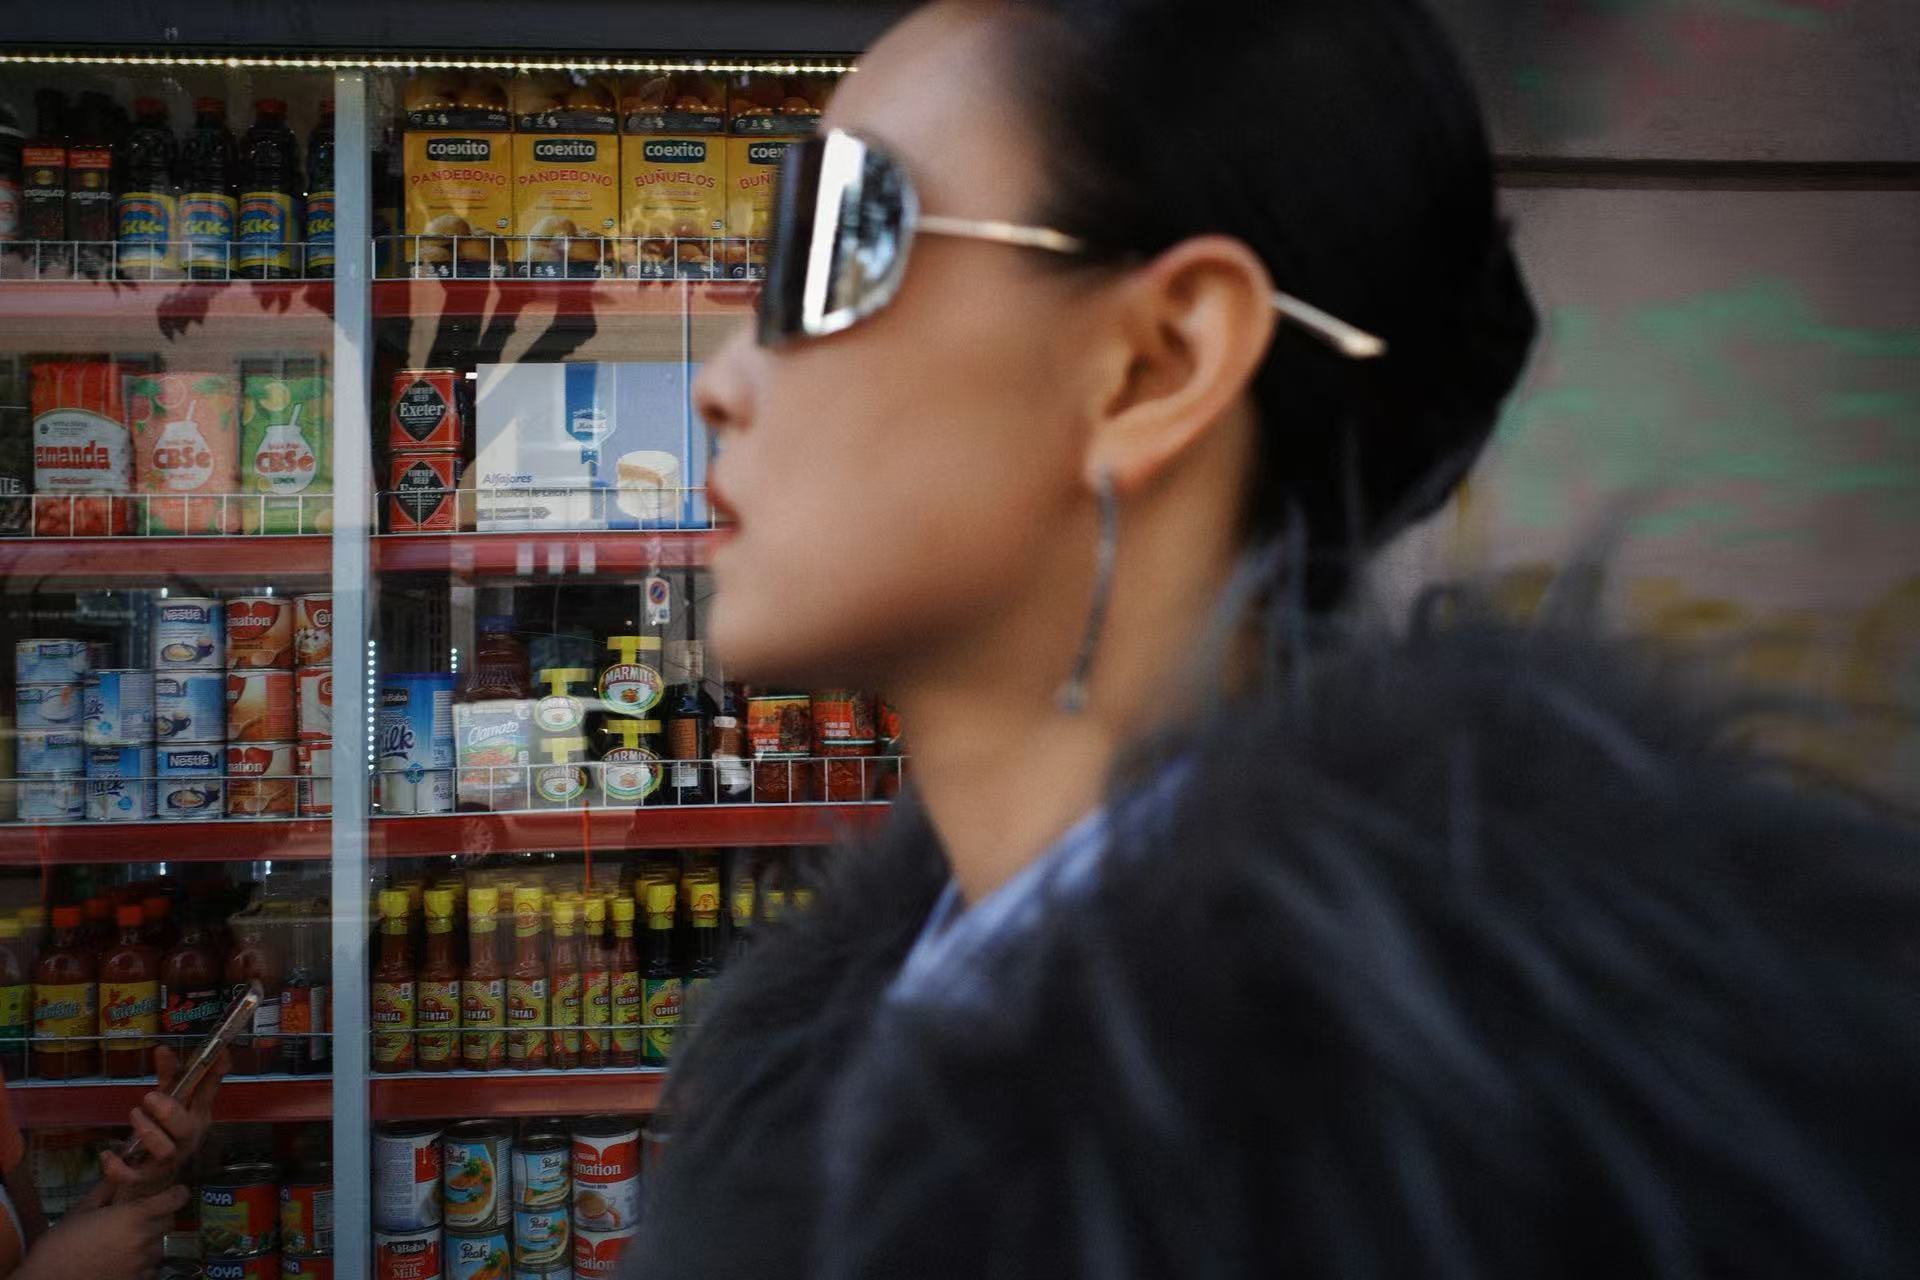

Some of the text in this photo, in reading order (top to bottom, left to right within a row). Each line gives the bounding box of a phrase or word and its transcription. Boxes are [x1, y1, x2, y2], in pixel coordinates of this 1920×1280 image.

[428, 140, 489, 156] coexito
[535, 141, 596, 157] coexito
[645, 142, 705, 158] coexito
[411, 168, 507, 187] PANDEBONO
[518, 169, 613, 187] PANDEBONO
[634, 169, 716, 188] BUÑUELOS
[400, 402, 445, 417] Exeter
[36, 440, 110, 468] amanda
[482, 472, 533, 487] Alfajores
[605, 665, 655, 683] MARMITE
[468, 720, 519, 746] Clamato
[460, 1242, 488, 1259] Peak
[207, 1265, 244, 1279] GOYA
